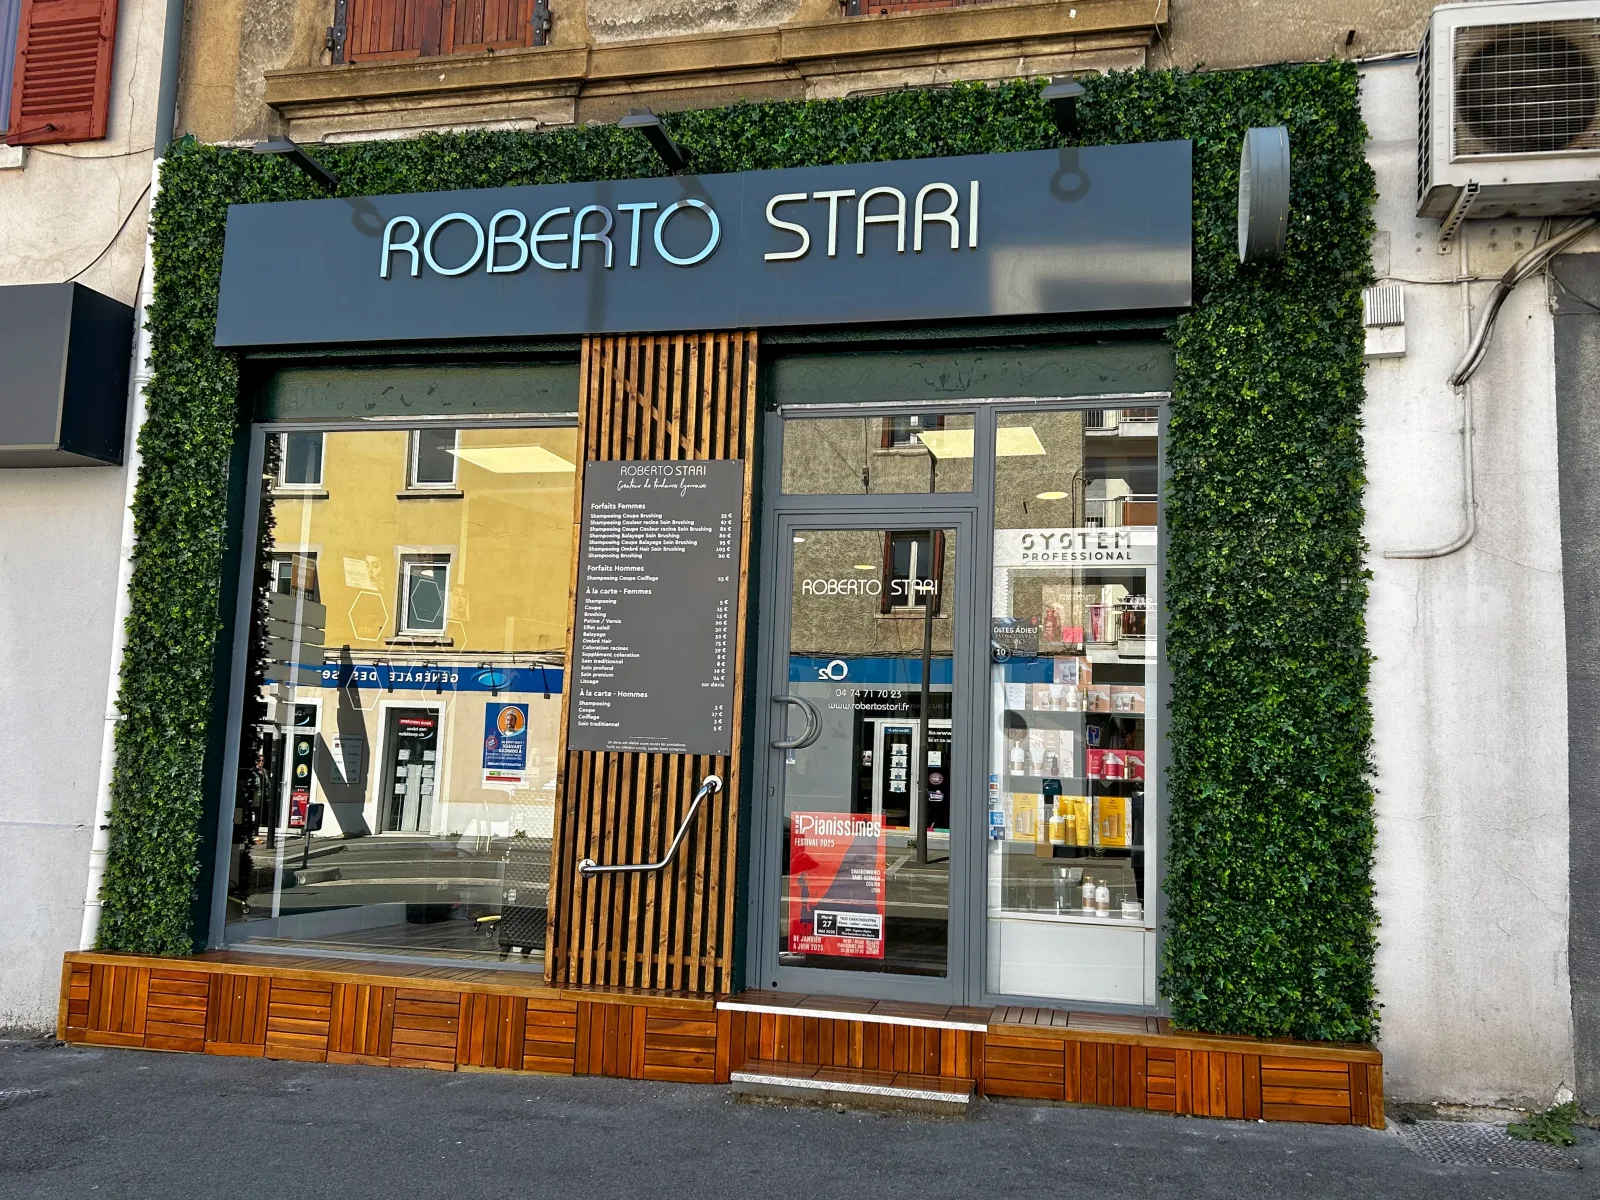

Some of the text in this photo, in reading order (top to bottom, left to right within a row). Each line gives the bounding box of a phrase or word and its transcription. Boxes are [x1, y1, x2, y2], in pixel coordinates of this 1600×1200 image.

[380, 180, 980, 279] ROBERTO STARI
[620, 465, 706, 476] ROBERTO STARI
[1022, 532, 1131, 550] SYSTEM
[1023, 552, 1131, 560] PROFESSIONAL
[802, 579, 937, 595] ROBERTO STARI
[836, 689, 846, 697] 04
[891, 690, 901, 698] 23
[828, 702, 909, 711] www.robertostari.fr
[800, 815, 880, 837] Pianissimes
[795, 838, 818, 846] FESTIVAL
